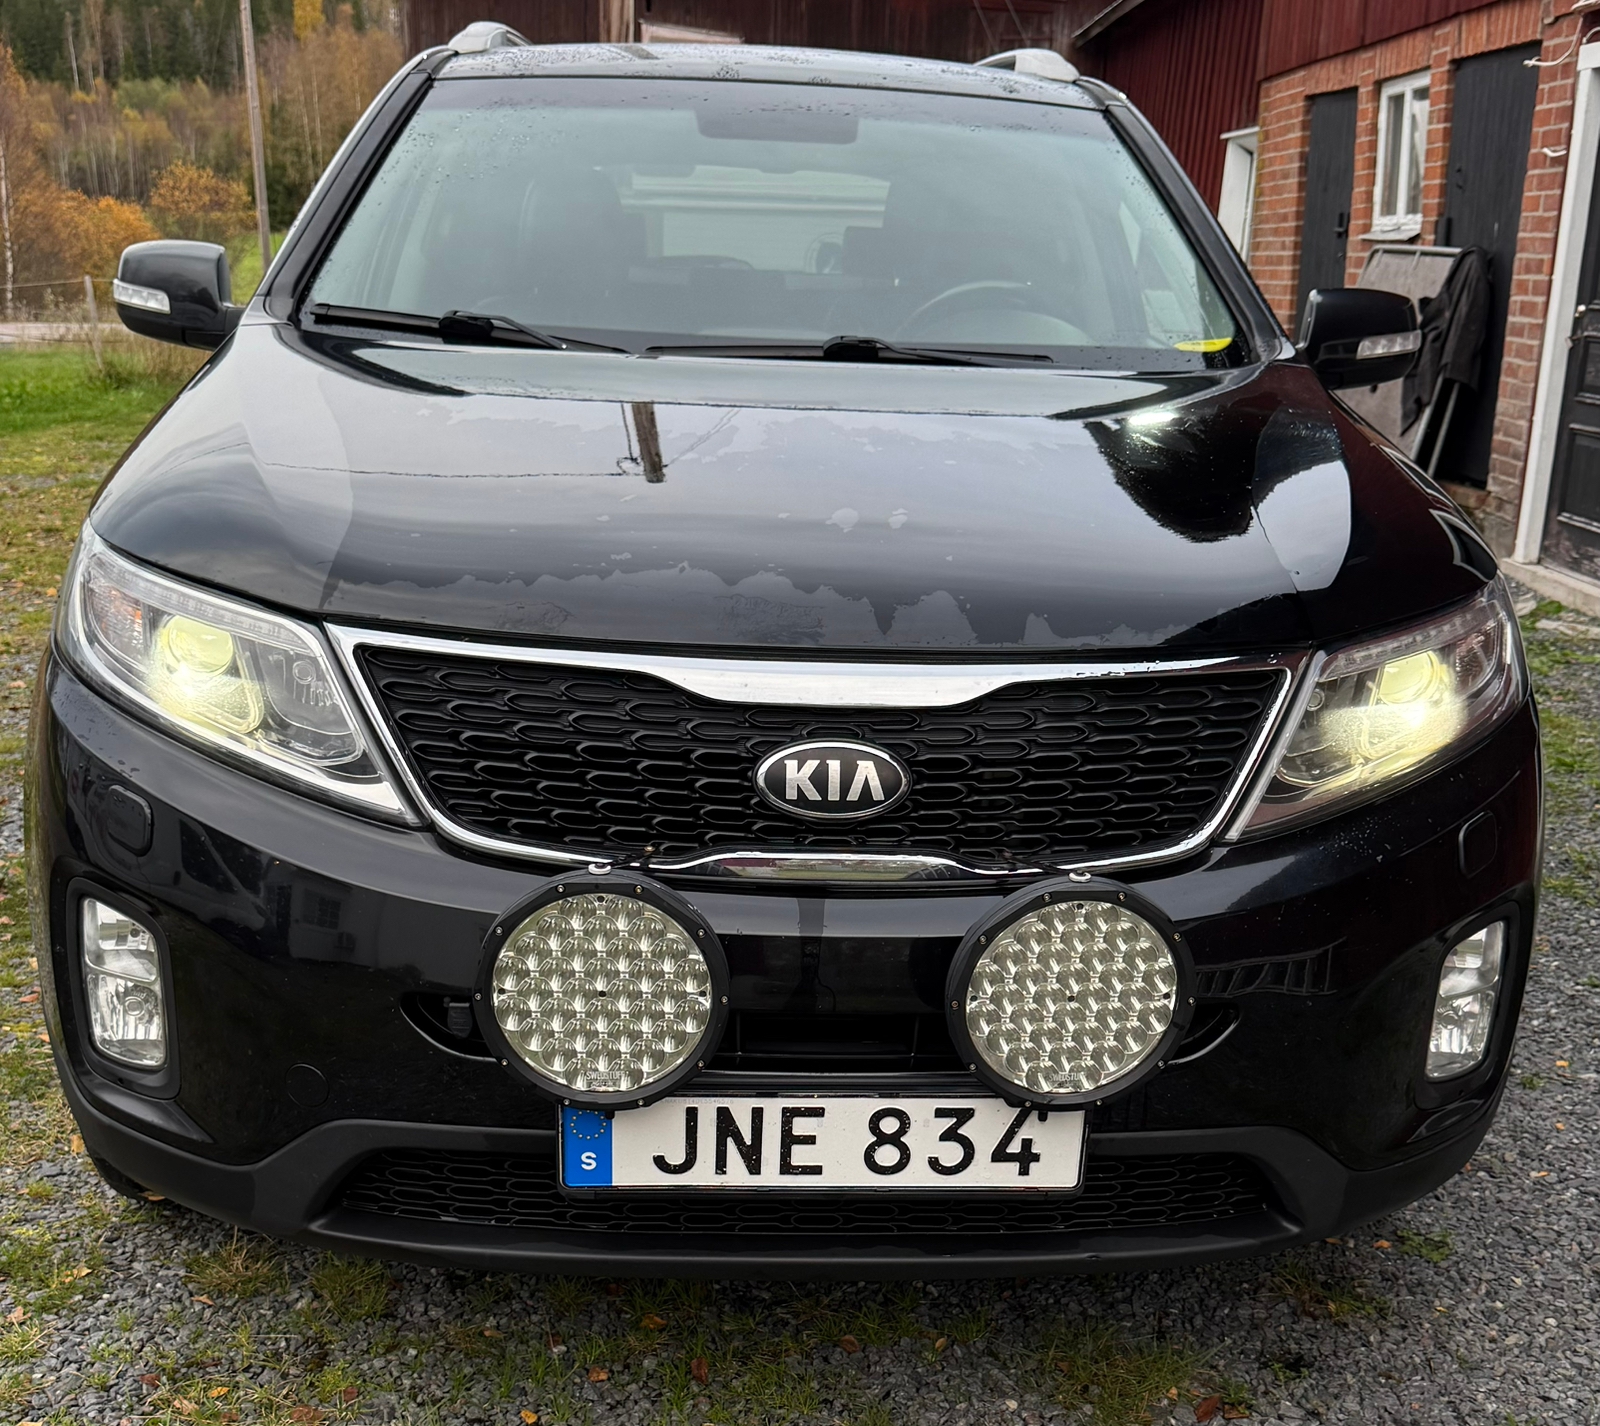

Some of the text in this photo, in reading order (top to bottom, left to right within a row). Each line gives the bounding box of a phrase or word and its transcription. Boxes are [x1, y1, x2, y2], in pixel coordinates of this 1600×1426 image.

[784, 759, 885, 801] KIA
[581, 1151, 597, 1171] S
[652, 1106, 1041, 1176] JNE 834
